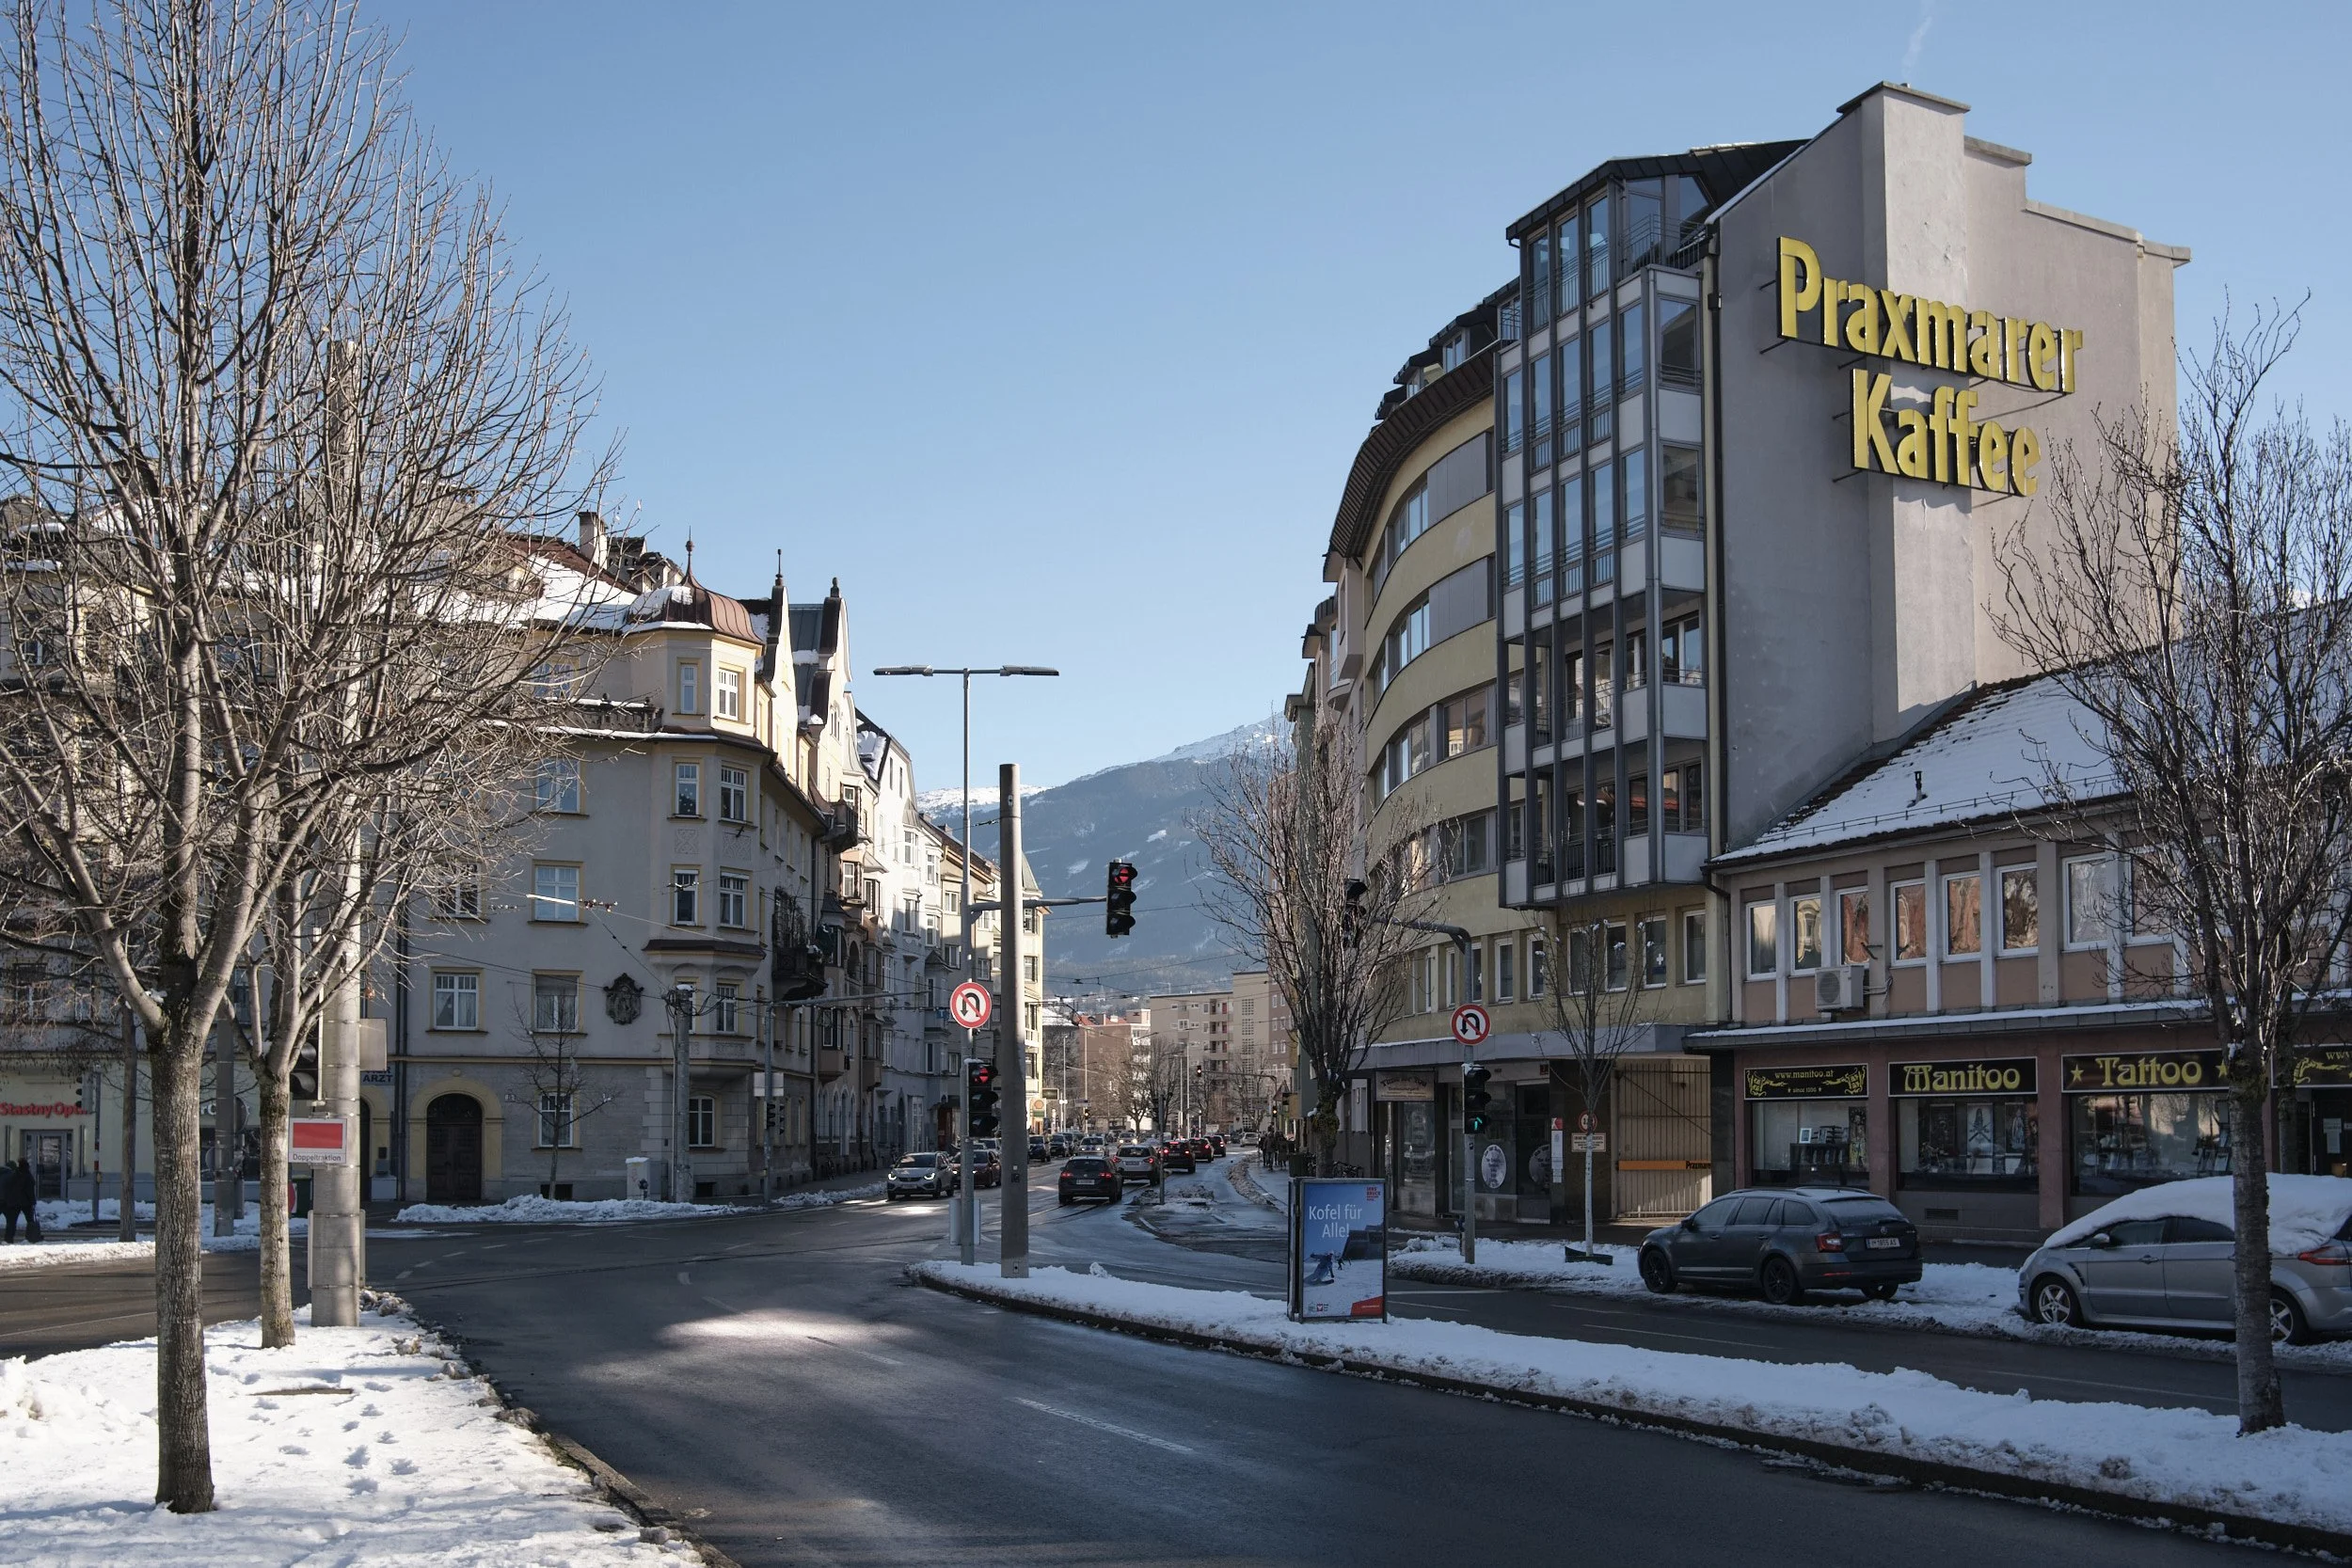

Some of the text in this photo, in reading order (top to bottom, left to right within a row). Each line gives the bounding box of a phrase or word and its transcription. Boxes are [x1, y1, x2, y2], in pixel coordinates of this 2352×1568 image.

[1777, 236, 2083, 394] Praxmarer
[1851, 369, 2042, 498] Kaffee
[362, 1074, 393, 1083] ARZT
[1774, 1069, 1835, 1079] www.manitoo.at
[1903, 1064, 2022, 1092] Manitoo
[2095, 1056, 2202, 1087] Tattoo
[293, 1153, 342, 1162] Doppeltraktion
[1309, 1204, 1362, 1220] Kofel für
[1322, 1222, 1350, 1239] Alle!
